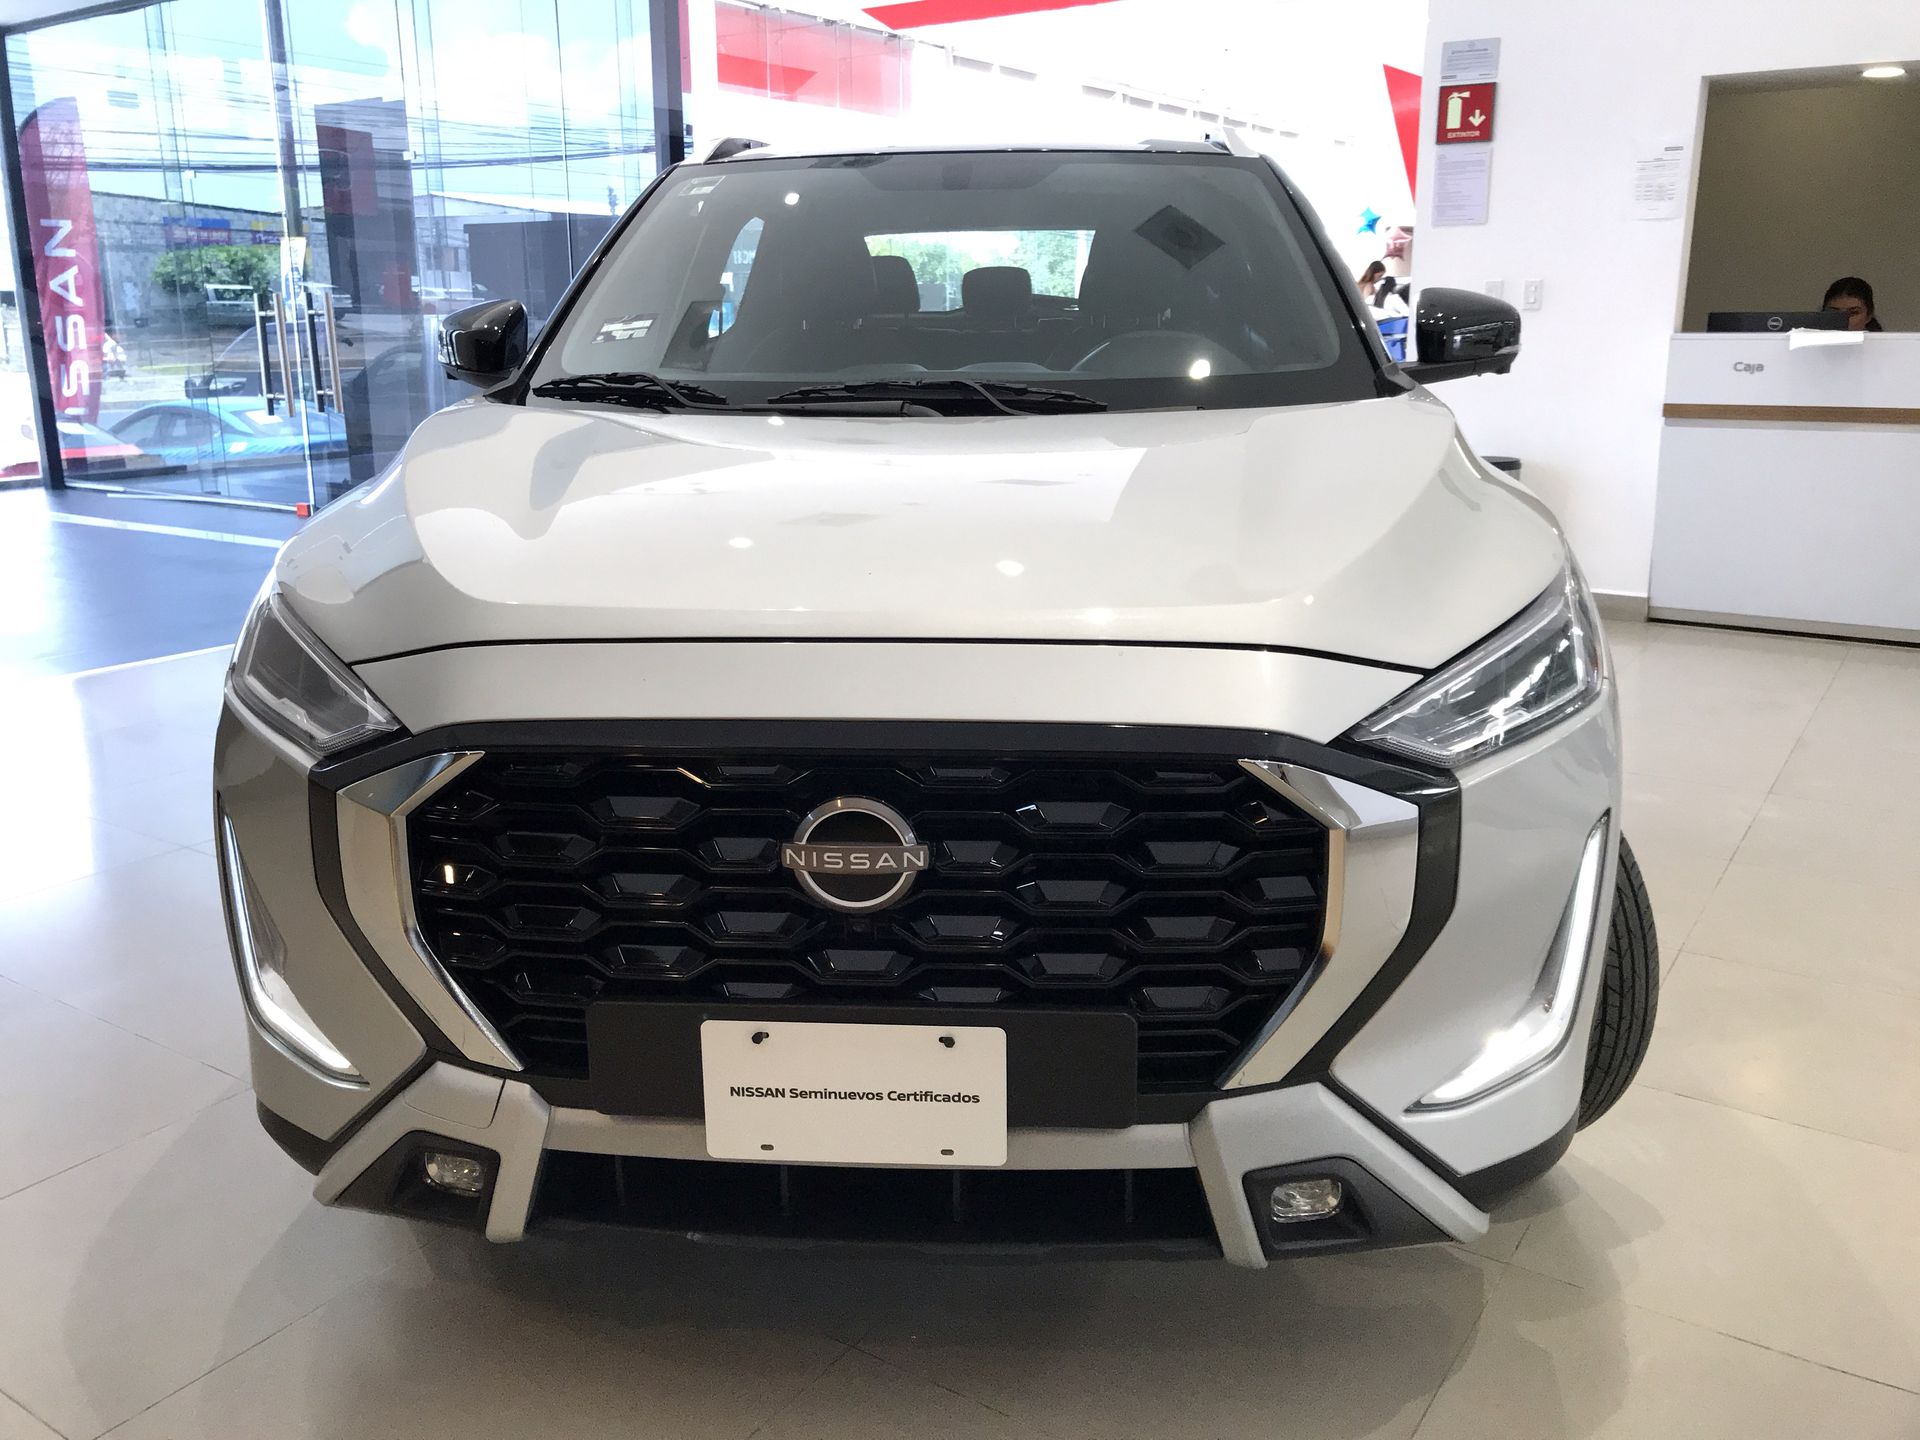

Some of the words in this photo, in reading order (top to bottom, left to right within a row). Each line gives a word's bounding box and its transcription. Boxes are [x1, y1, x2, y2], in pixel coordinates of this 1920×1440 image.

[39, 218, 91, 416] ISSAN
[1733, 361, 1765, 374] Caja
[786, 849, 924, 869] NISSAN
[729, 1086, 786, 1099] NISSAN
[789, 1087, 884, 1101] Seminuevos
[887, 1090, 981, 1104] Certificados
